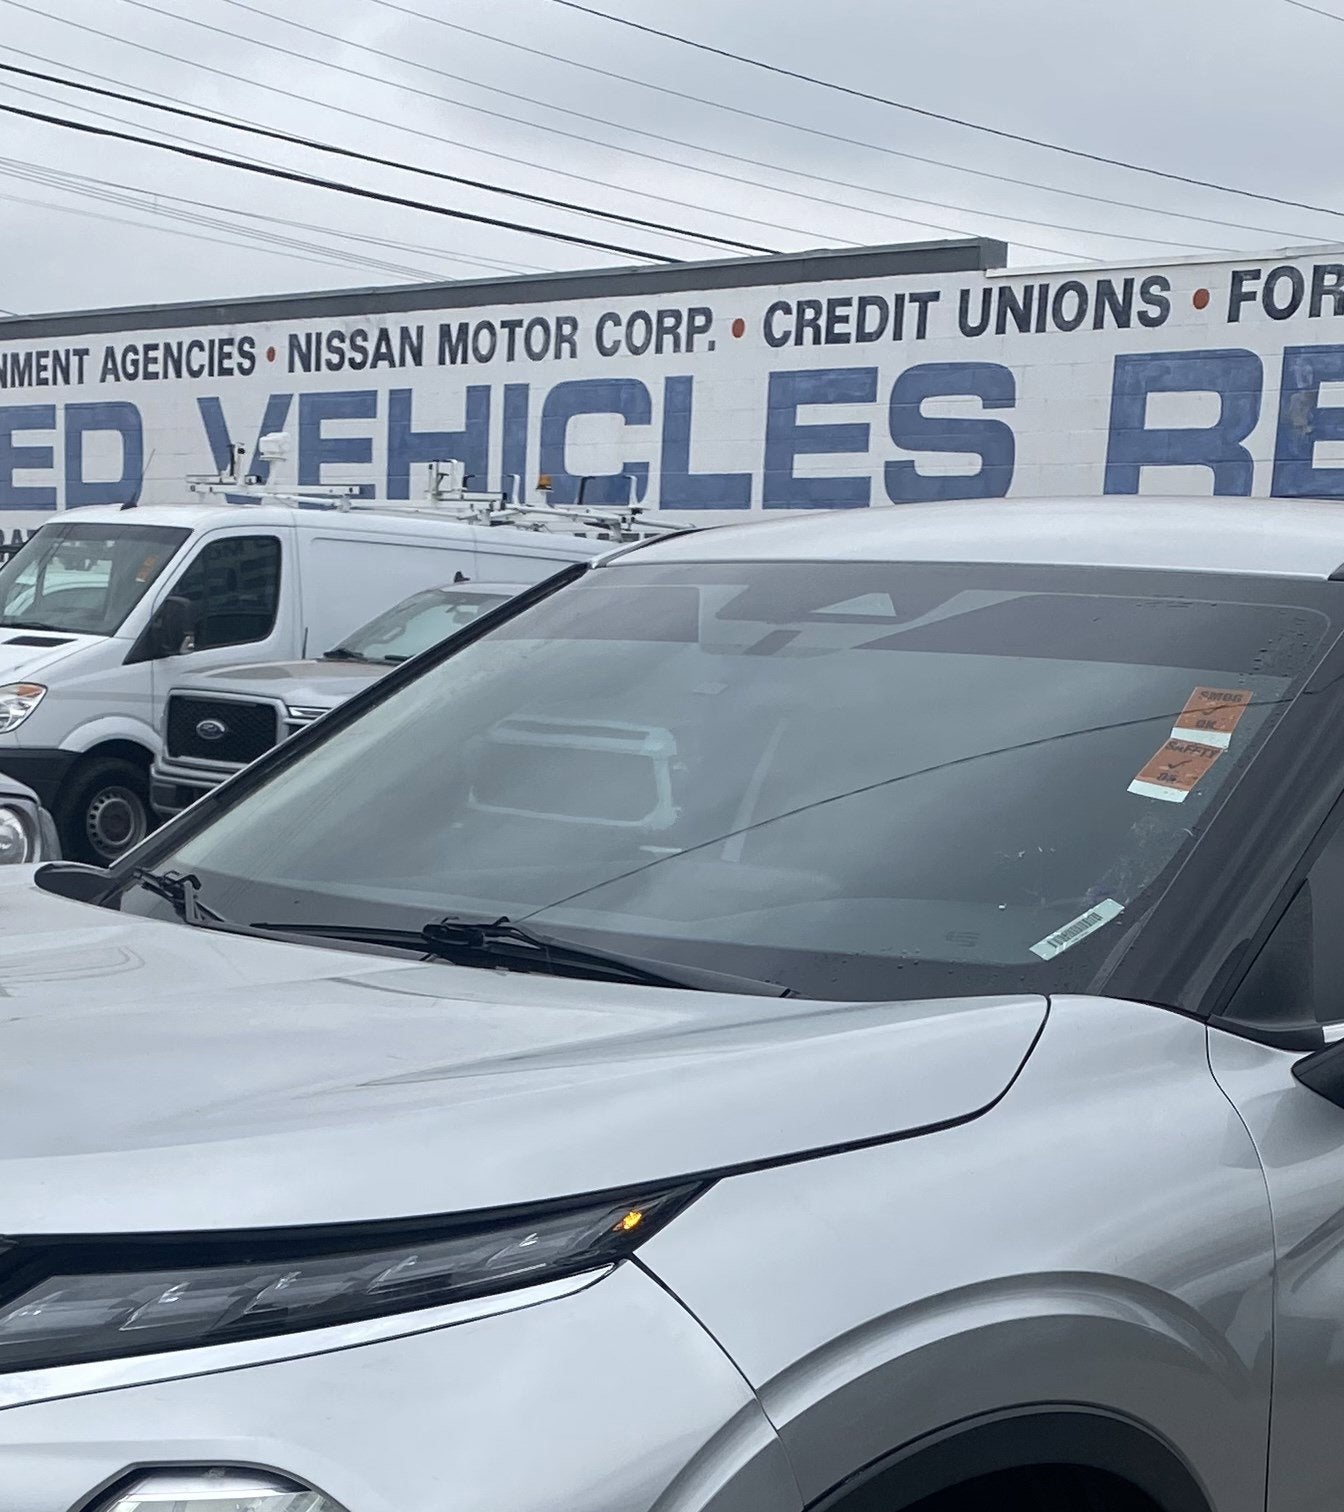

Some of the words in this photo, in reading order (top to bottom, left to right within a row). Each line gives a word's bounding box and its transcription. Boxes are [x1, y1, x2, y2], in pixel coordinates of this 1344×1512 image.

[99, 336, 256, 383] AGENCIES
[288, 325, 424, 374] NISSAN
[438, 315, 578, 365] MOTOR
[595, 306, 716, 357] CORP.
[763, 290, 940, 348] CREDIT
[959, 275, 1171, 338] UNIONS
[197, 362, 1016, 511] VEHICLES
